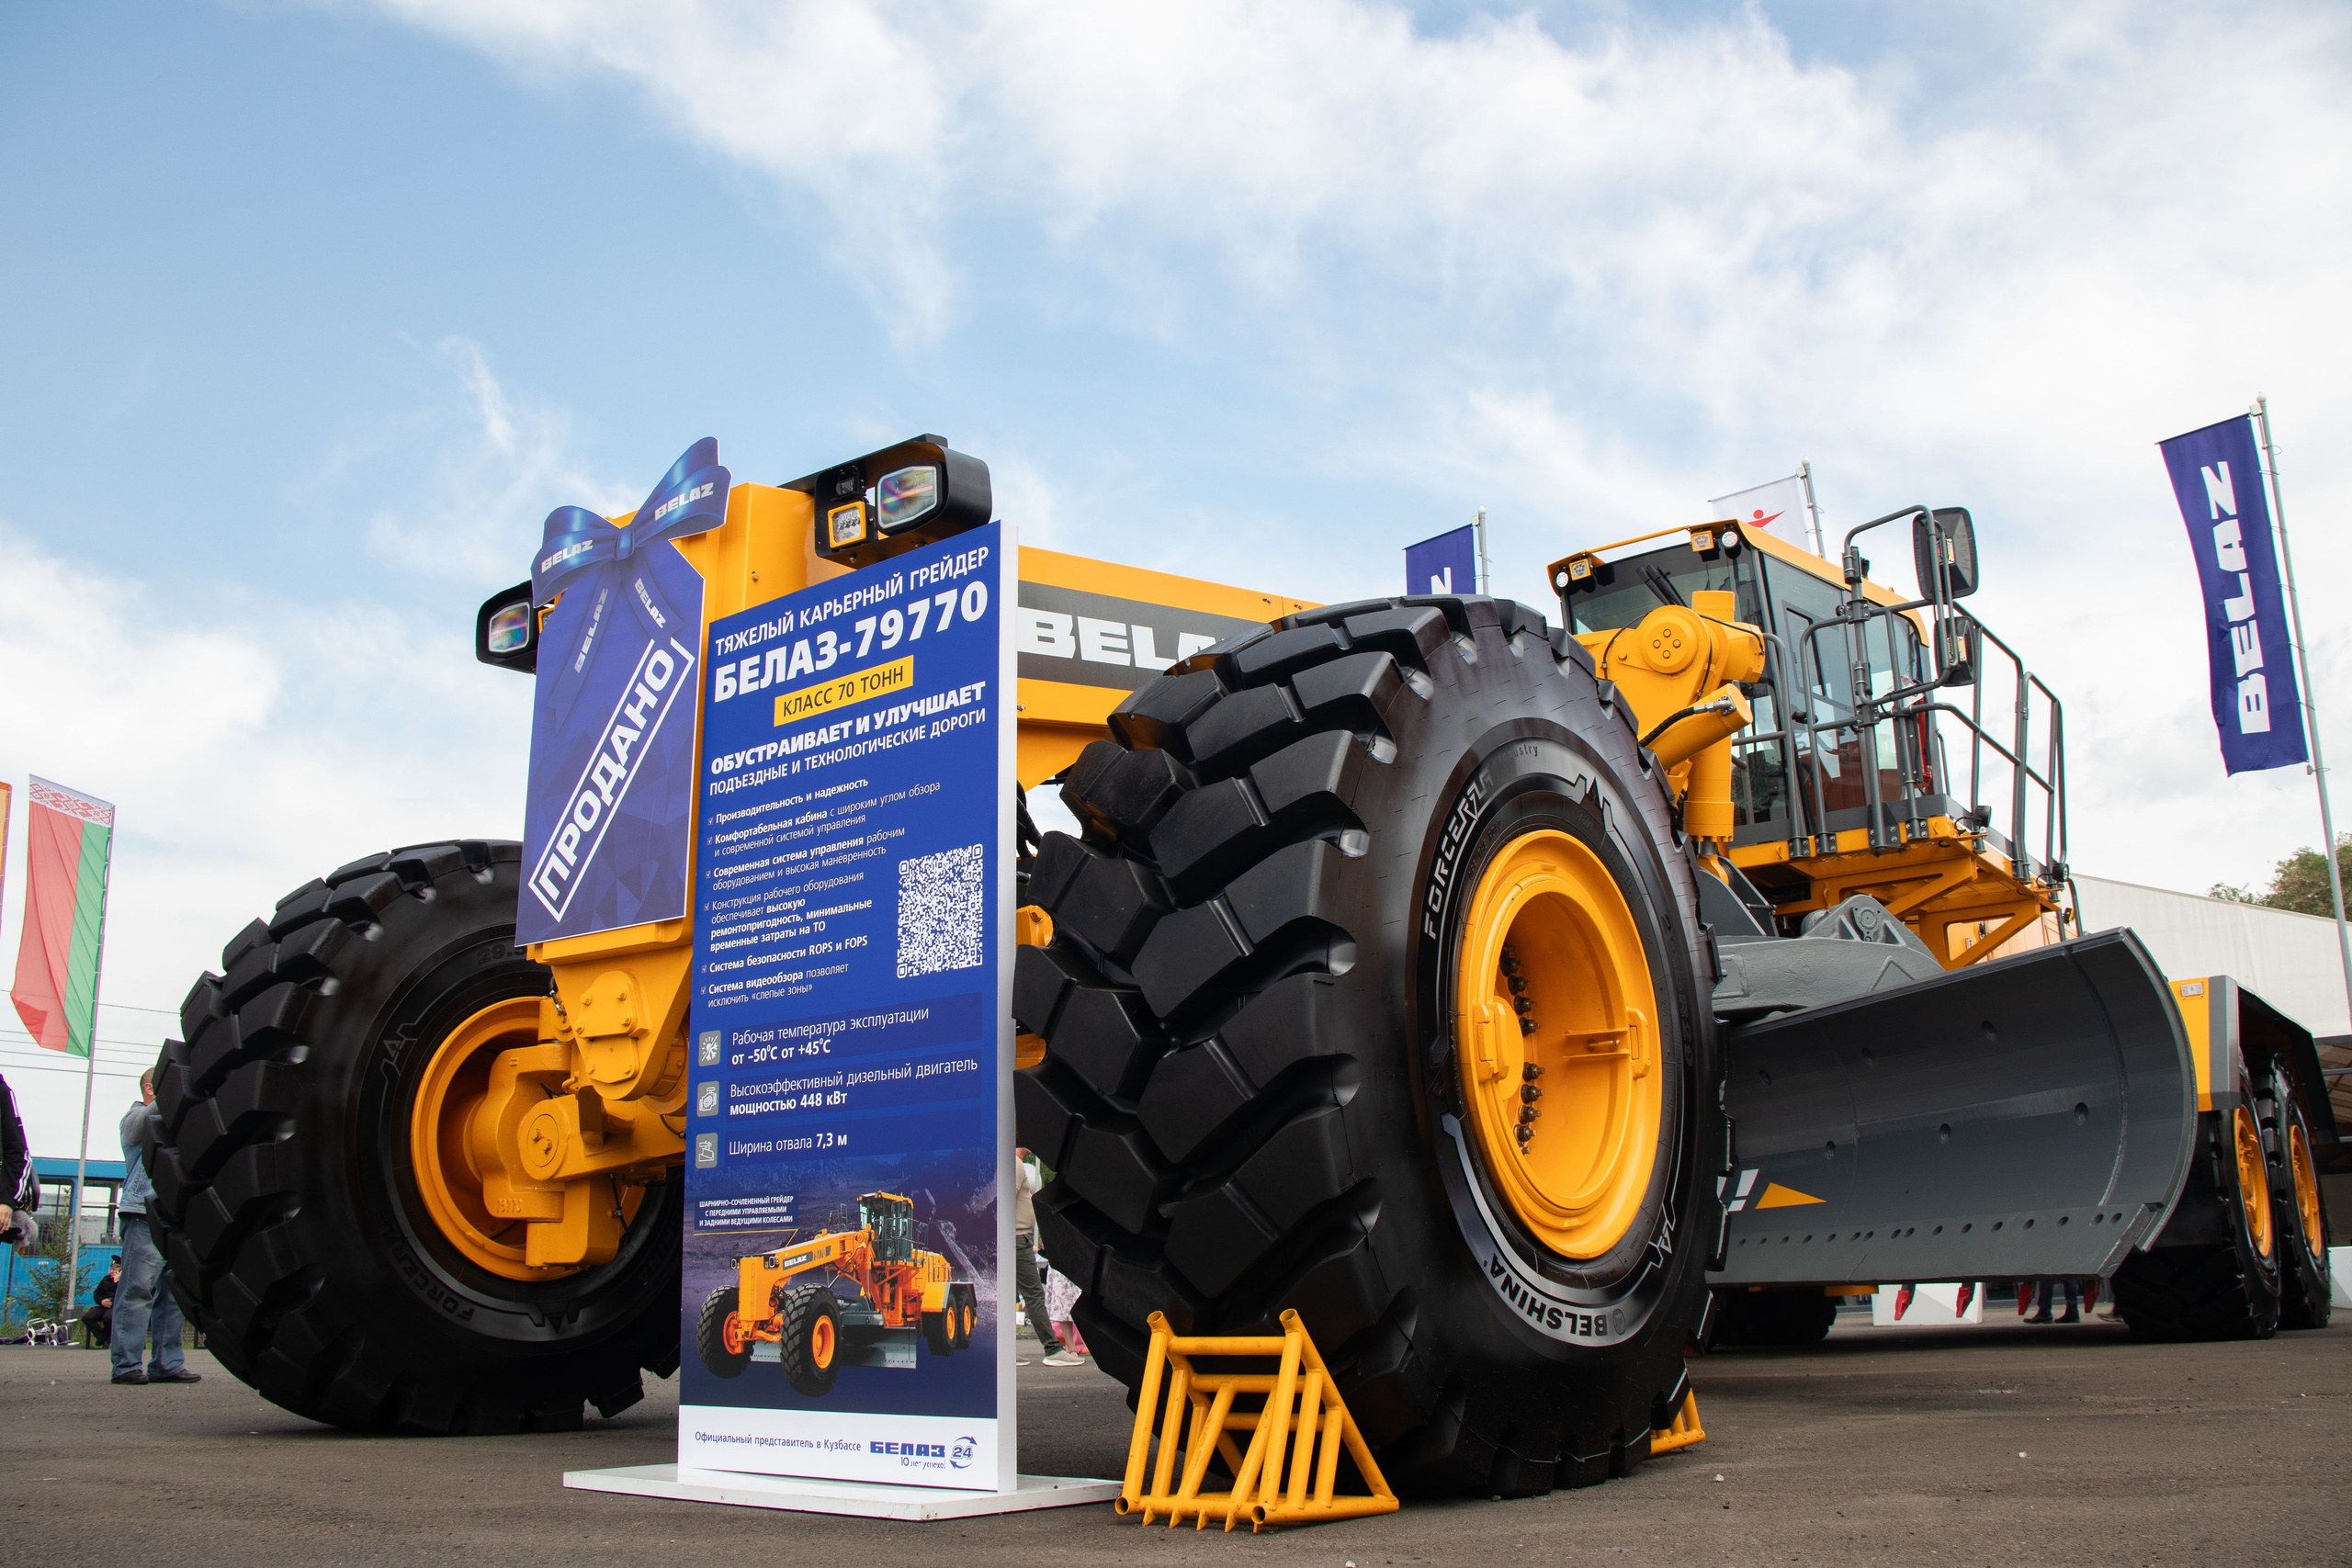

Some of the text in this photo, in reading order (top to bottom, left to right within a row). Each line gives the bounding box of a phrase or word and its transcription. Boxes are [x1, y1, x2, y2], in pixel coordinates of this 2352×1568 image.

[654, 482, 714, 521] BELAZ
[541, 539, 594, 574] BELAZ
[634, 578, 666, 628] BELAZ
[716, 547, 989, 657] ТЯЖЕЛЫЙ КАРЬЕРНЫЙ ГРЕЙДЕР
[2200, 461, 2271, 734] BELAZ
[574, 588, 608, 673] BELAZ
[715, 581, 989, 703] БЕЛАЗ-79770
[783, 665, 903, 717] КЛАСС 70 ТОНН
[711, 681, 986, 774] ОБУСТРАИВАЕТ И УЛУЧШАЕТ
[709, 707, 986, 795] ПОДЪЕЗДНЫЕ И ТЕХНОЛОГИЧЕСКИЕ ДОРОГИ
[538, 649, 674, 901] ПРОДАНО
[715, 782, 941, 844] Комфортабельная кабина с широким углом обзора
[716, 778, 868, 825] Производительность и надежность
[713, 827, 905, 878] Современная система управления рабочим
[714, 814, 866, 857] и современной системой управления
[712, 845, 887, 891] оборудованием и высокая манёвренность
[711, 897, 806, 925] обеспечивает высокую
[712, 872, 865, 911] Конструкция рабочего оборудования
[710, 899, 873, 940] ремонтопригодность, минимальные
[710, 920, 826, 953] временные затраты на ТО
[709, 935, 868, 973] Система безопасности ROPS и FOPS
[707, 983, 813, 1008] исключить «слепые зоны»
[708, 964, 850, 994] Система видеообзора позволяет
[731, 1008, 929, 1045] Рабочая температура эксплуатации
[731, 1052, 744, 1066] от
[781, 1046, 794, 1059] от
[730, 1057, 978, 1100] Высокоэффективный дизельный двигатель
[729, 1090, 847, 1117] мощностью 448 кВт
[729, 1133, 847, 1156] Ширина отвала 7,3 м
[709, 1208, 741, 1217] ПЕРЕДНИМИ
[741, 1205, 787, 1215] УПРАВЛЯЕМЫМИ
[770, 1194, 794, 1204] ГРЕЙДЕР
[704, 1218, 730, 1227] ЗАДНИМИ
[730, 1216, 763, 1226] ВЕДУЩИМИ
[763, 1215, 793, 1224] КОЛЕСАМИ
[784, 1255, 807, 1268] BELAZ
[1489, 1253, 1608, 1337] BELSHINA
[695, 1430, 861, 1452] Официальный представитель в Кузбассе
[870, 1440, 974, 1460] БЕЛАЗ 24
